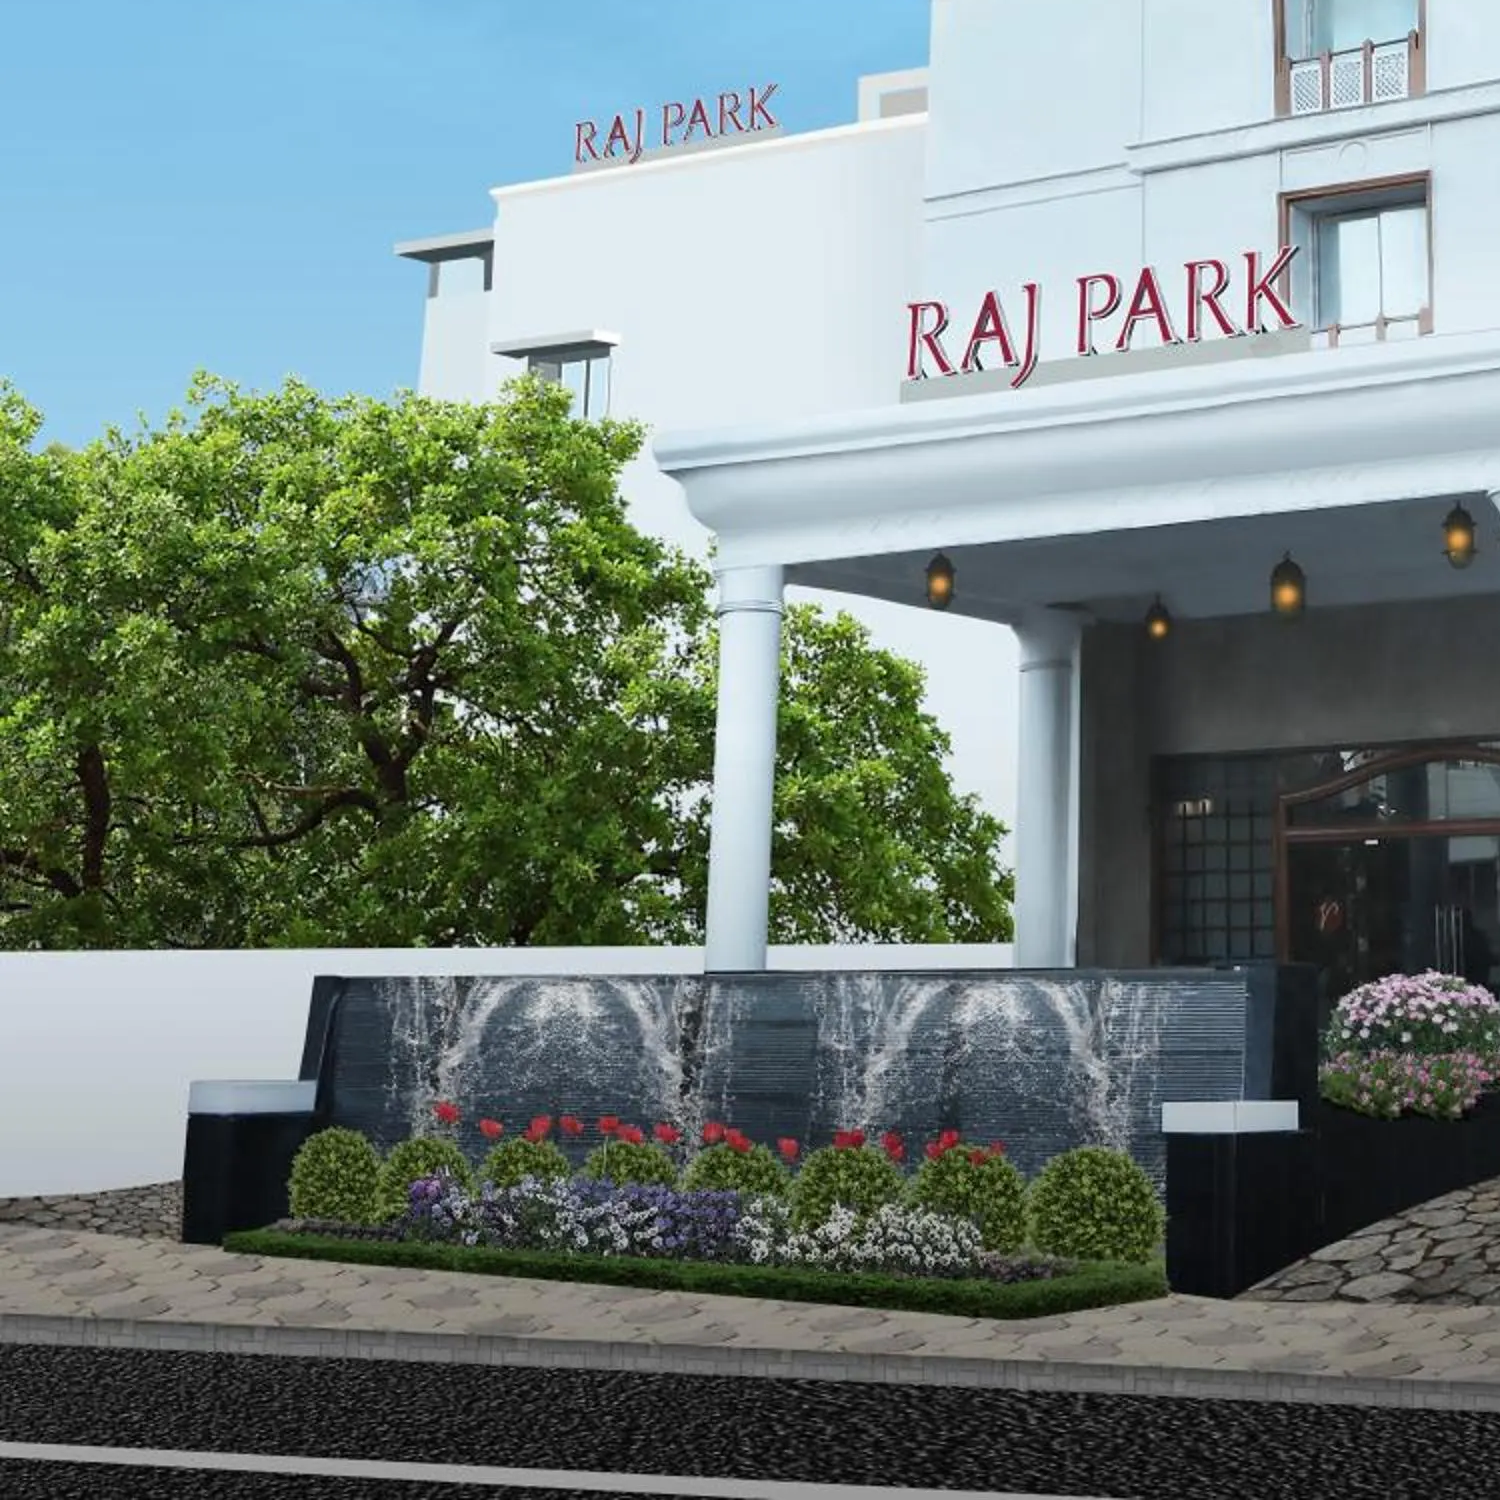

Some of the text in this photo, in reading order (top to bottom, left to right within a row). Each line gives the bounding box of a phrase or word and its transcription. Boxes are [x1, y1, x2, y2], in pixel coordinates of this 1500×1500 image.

[574, 83, 778, 165] RAJ PARK
[906, 244, 1302, 389] RAJ PARK
